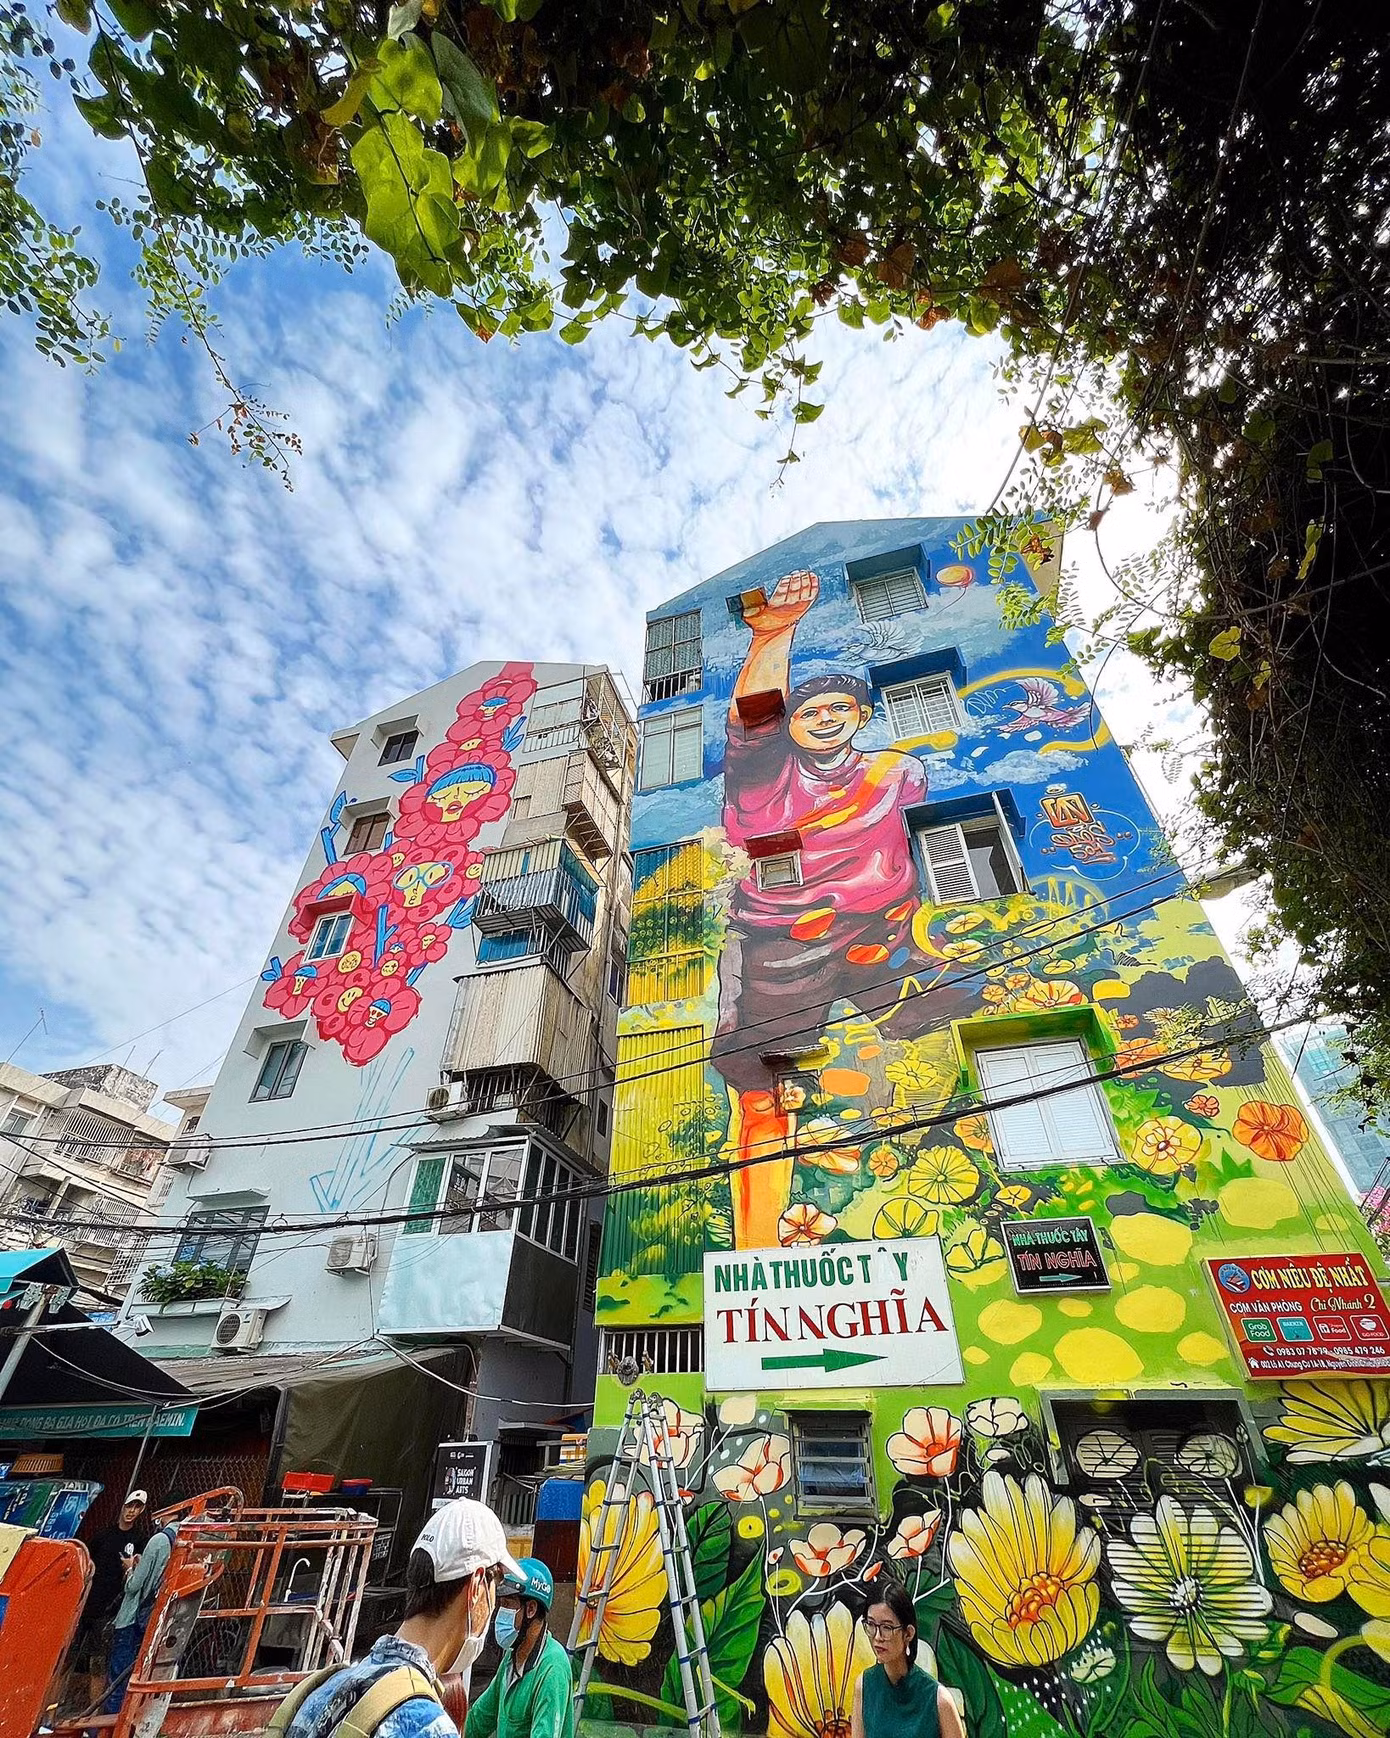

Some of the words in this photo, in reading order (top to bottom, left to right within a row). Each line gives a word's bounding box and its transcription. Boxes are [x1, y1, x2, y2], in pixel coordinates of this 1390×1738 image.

[1017, 1250, 1043, 1271] TÍN
[1044, 1247, 1098, 1269] NGHĨA
[714, 1256, 768, 1292] NHÀ
[769, 1248, 854, 1289] THUỐC
[1251, 1266, 1281, 1290] CƠM
[1309, 1261, 1333, 1293] ĐỆ
[1271, 1299, 1303, 1312] PHÒNG
[1364, 1293, 1376, 1309] 2
[716, 1296, 792, 1343] TÍN
[798, 1288, 949, 1340] NGHĨA
[1248, 1322, 1268, 1330] Grab
[1250, 1330, 1271, 1338] Food
